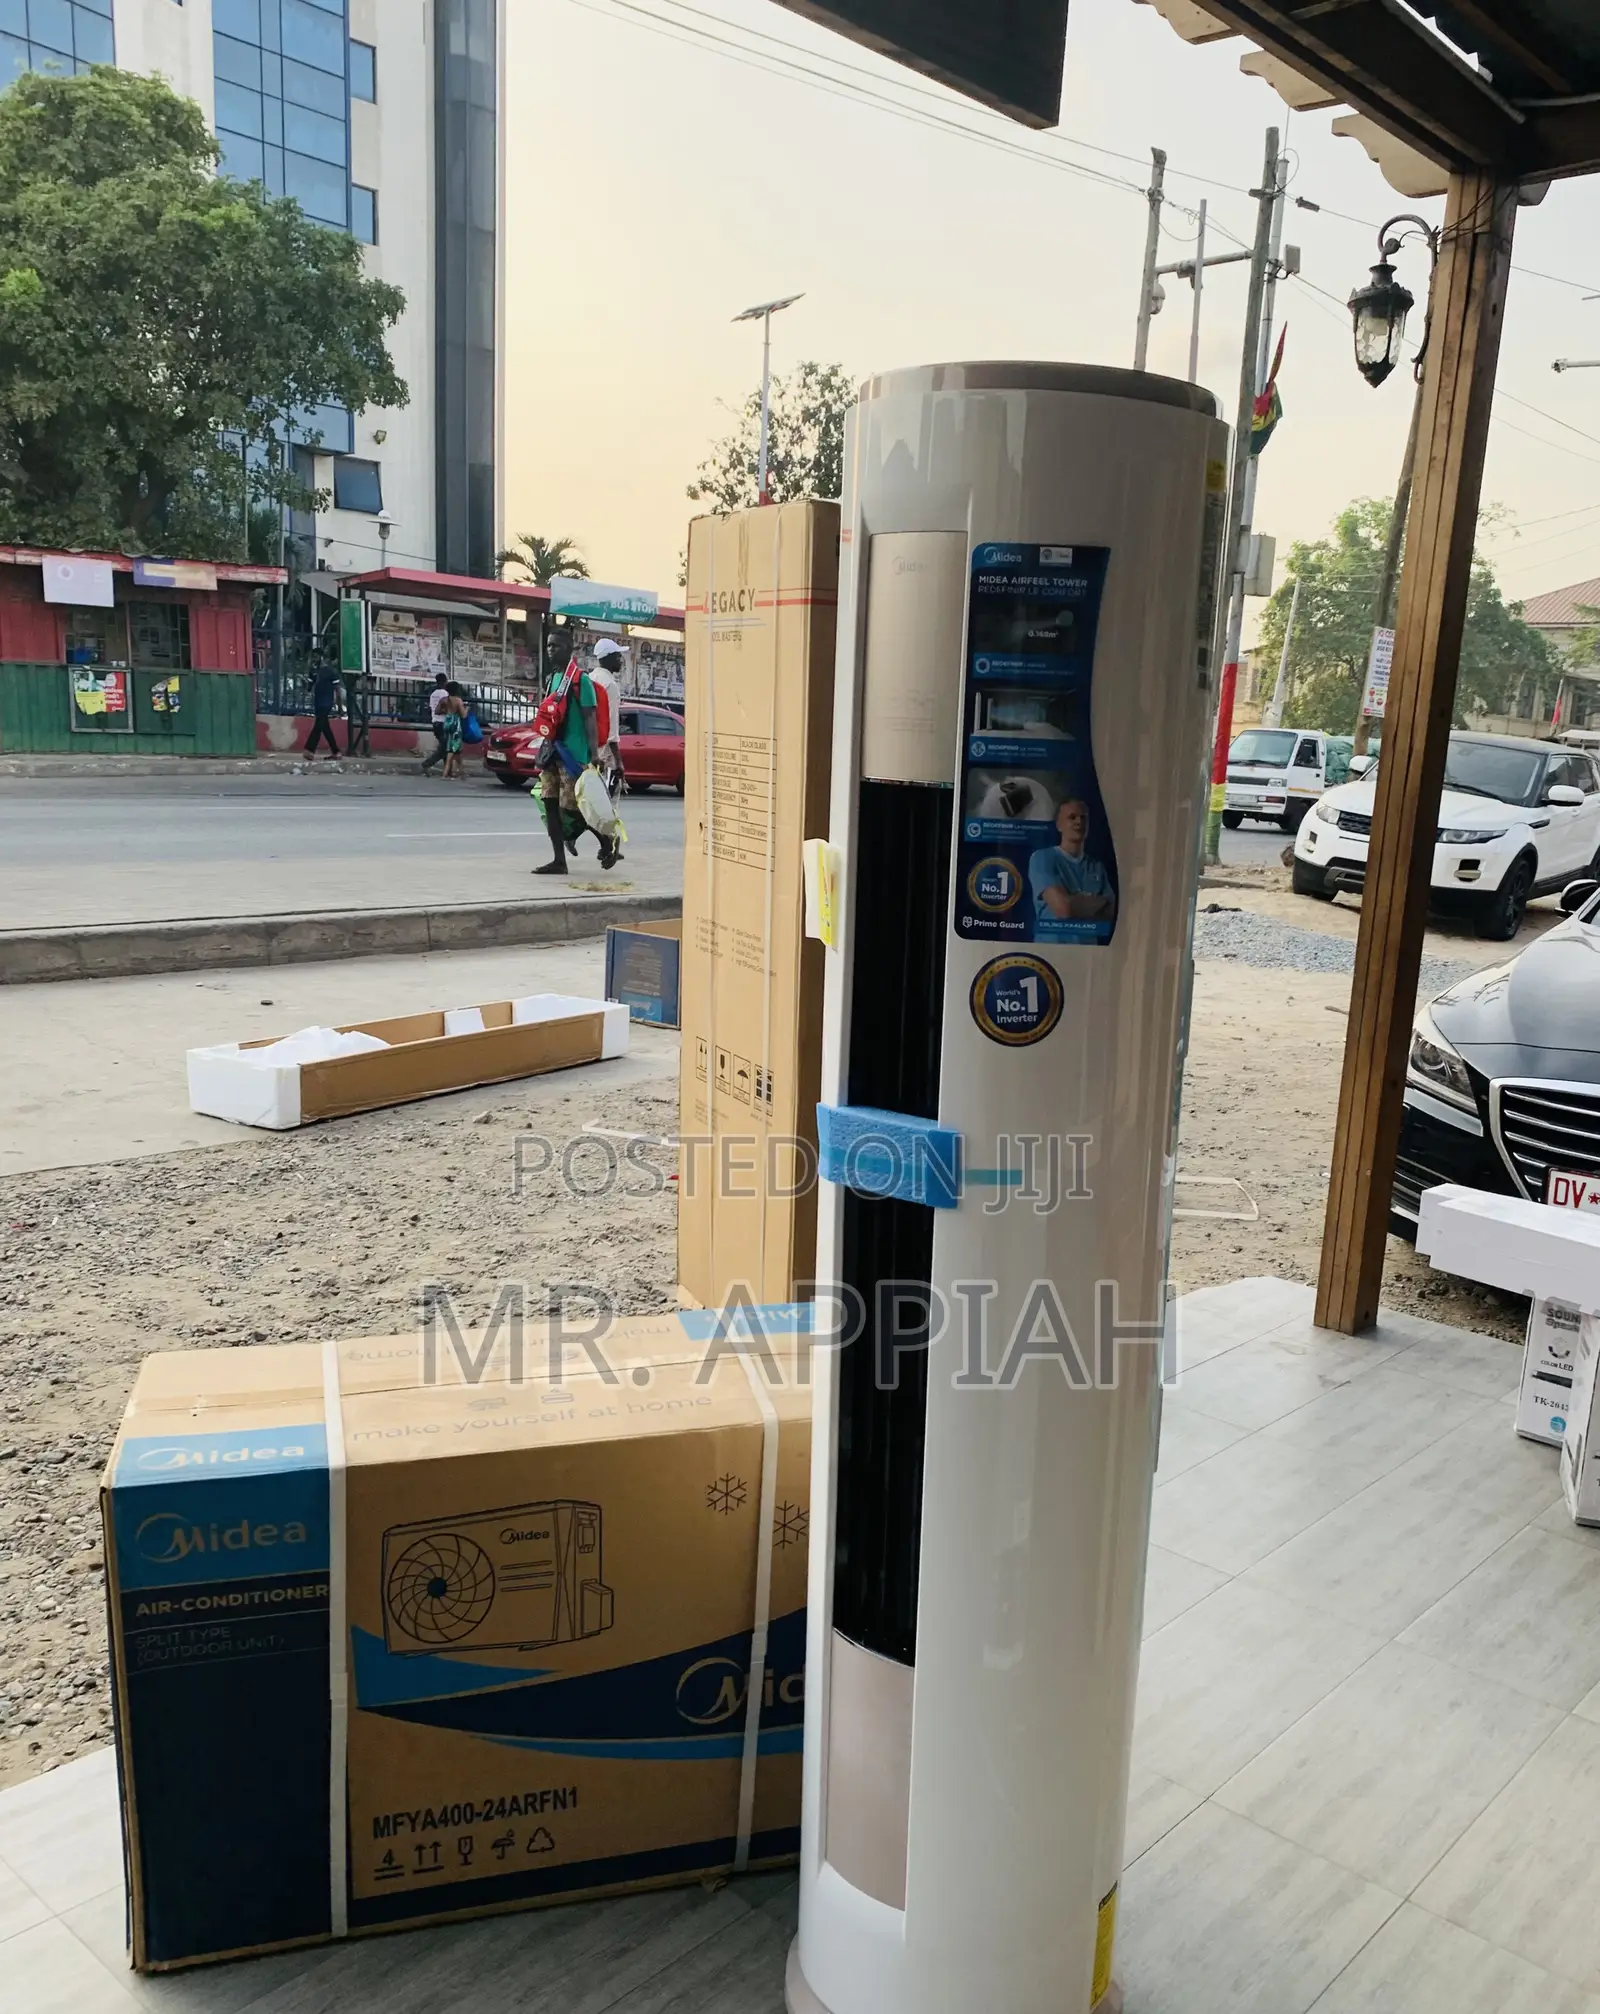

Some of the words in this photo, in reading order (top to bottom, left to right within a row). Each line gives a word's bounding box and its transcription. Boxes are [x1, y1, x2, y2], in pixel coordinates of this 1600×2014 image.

[978, 575, 1008, 584] MIDEA
[1011, 577, 1050, 586] AIRFEEL
[1053, 578, 1088, 588] TOWER
[974, 919, 997, 928] Prime
[999, 921, 1024, 930] Guard
[996, 1014, 1038, 1024] Inverter
[1553, 1177, 1587, 1208] DV
[1547, 1308, 1581, 1325] SOUN
[1559, 1361, 1574, 1372] LED
[353, 1425, 441, 1441] make
[454, 1408, 578, 1434] yourself
[588, 1404, 620, 1418] at
[627, 1395, 713, 1415] home
[138, 1445, 305, 1471] Midea
[135, 1512, 306, 1563] Midea
[499, 1528, 550, 1544] Midea
[136, 1585, 329, 1616] AIR-CONDITIONER
[675, 1656, 806, 1724] Mid
[373, 1786, 578, 1839] MFYA400-24ARFN1
